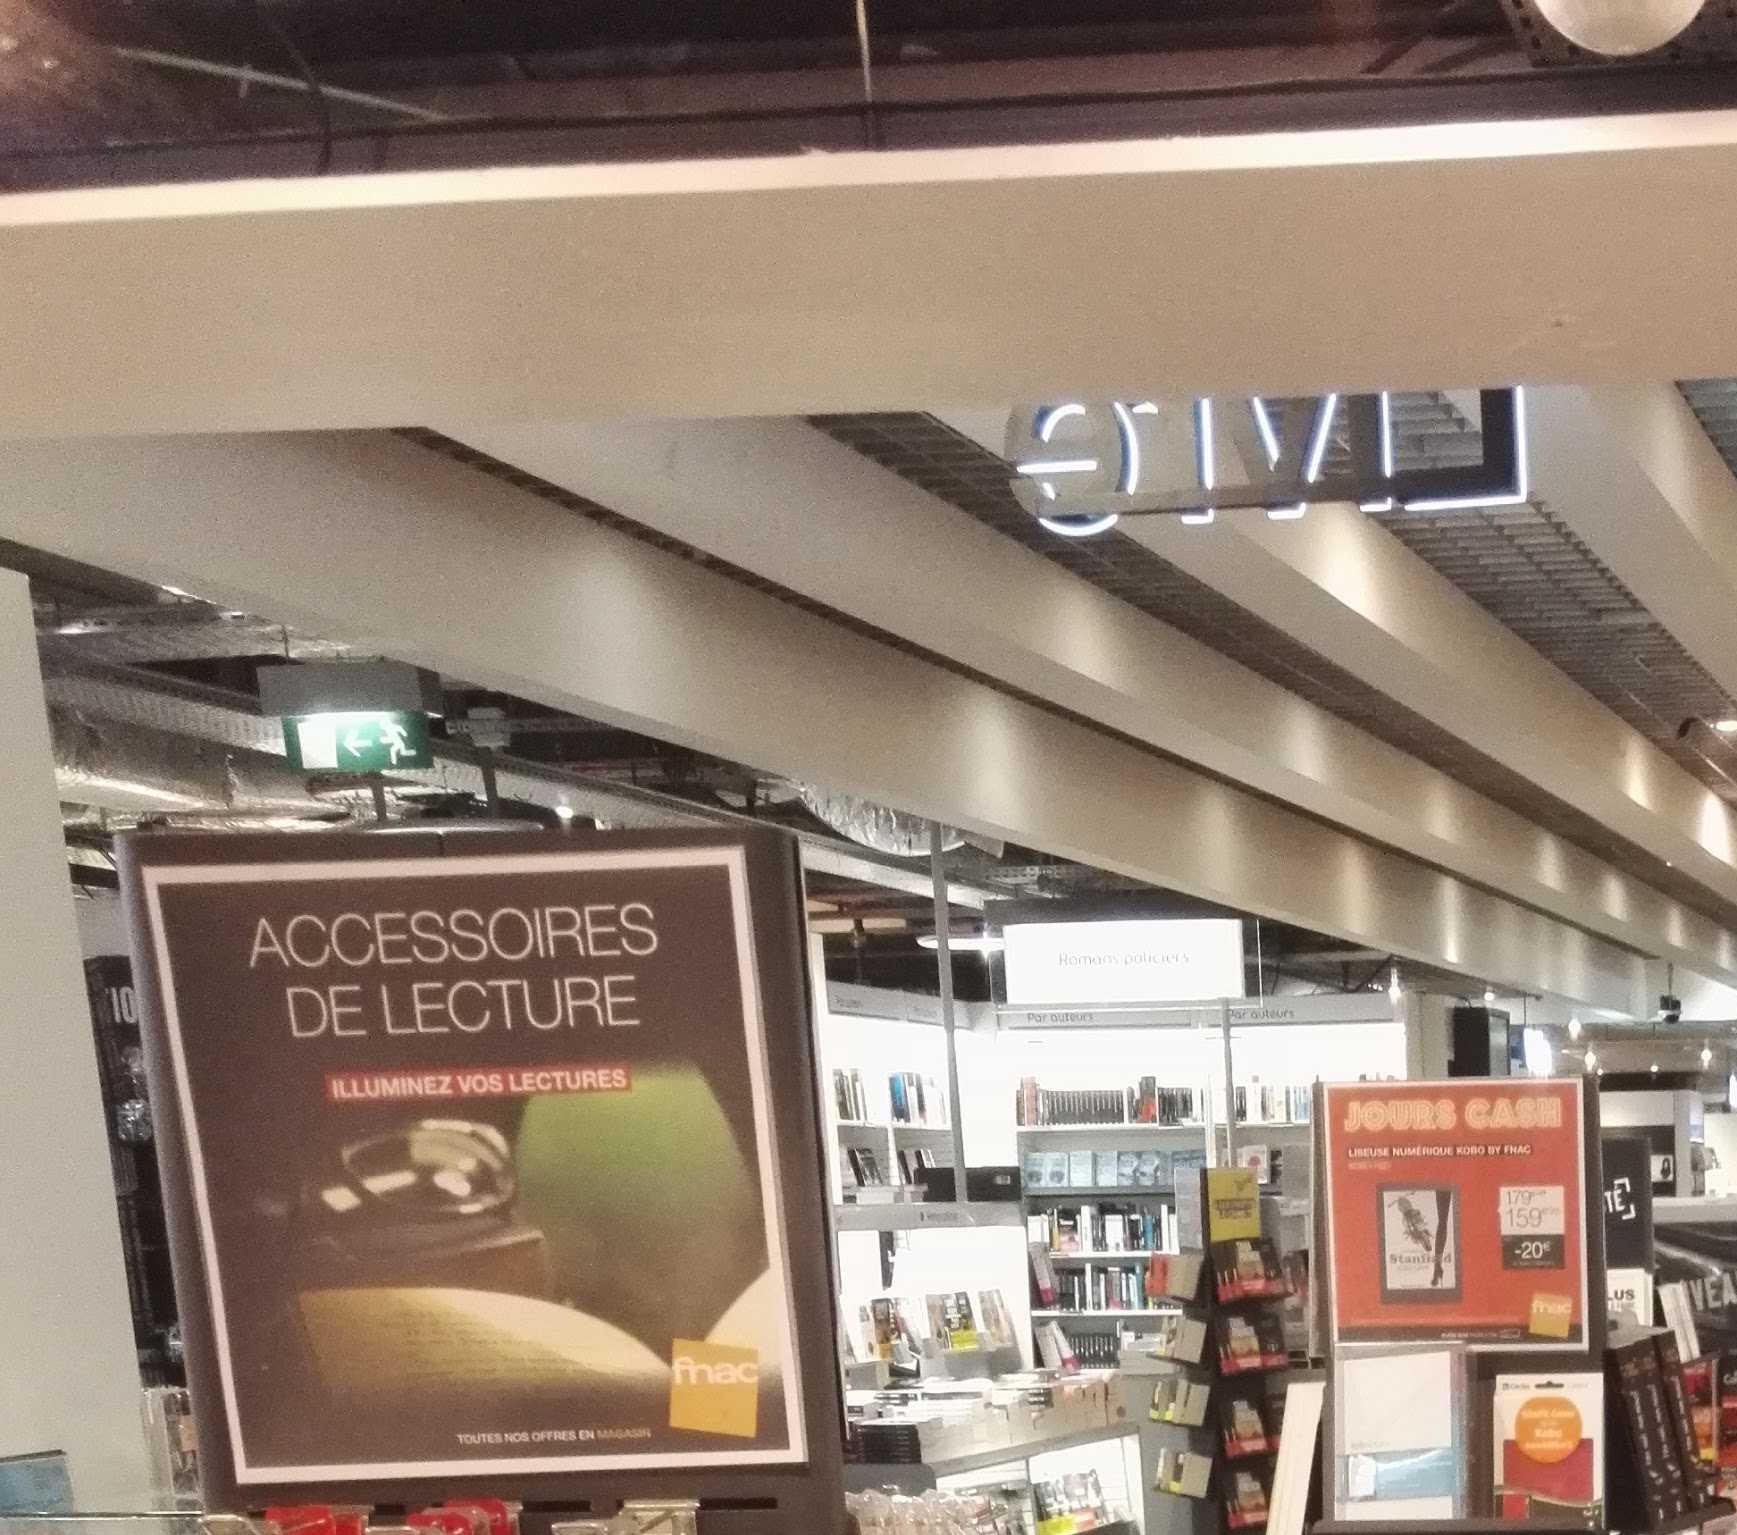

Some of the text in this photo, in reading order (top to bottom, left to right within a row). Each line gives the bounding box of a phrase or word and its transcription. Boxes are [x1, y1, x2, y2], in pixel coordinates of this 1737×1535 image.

[249, 902, 659, 969] ACCESSOIRES
[1058, 950, 1191, 968] Romans policiers
[285, 974, 641, 1038] DE LECTURE
[1250, 1007, 1295, 1020] auteurs
[1049, 1011, 1094, 1023] auteurs
[332, 1068, 627, 1099] ILLUMINEZ VOS LECTURES
[1344, 1097, 1562, 1132] JOURS CASH
[1348, 1144, 1531, 1158] LISEUSE NUMÉRIQUE KOBO BY FNAC
[1532, 1300, 1572, 1314] fnac
[671, 1355, 759, 1386] fnac
[457, 1427, 651, 1445] TOUTES NOS OFFRES EN MAGASIN
